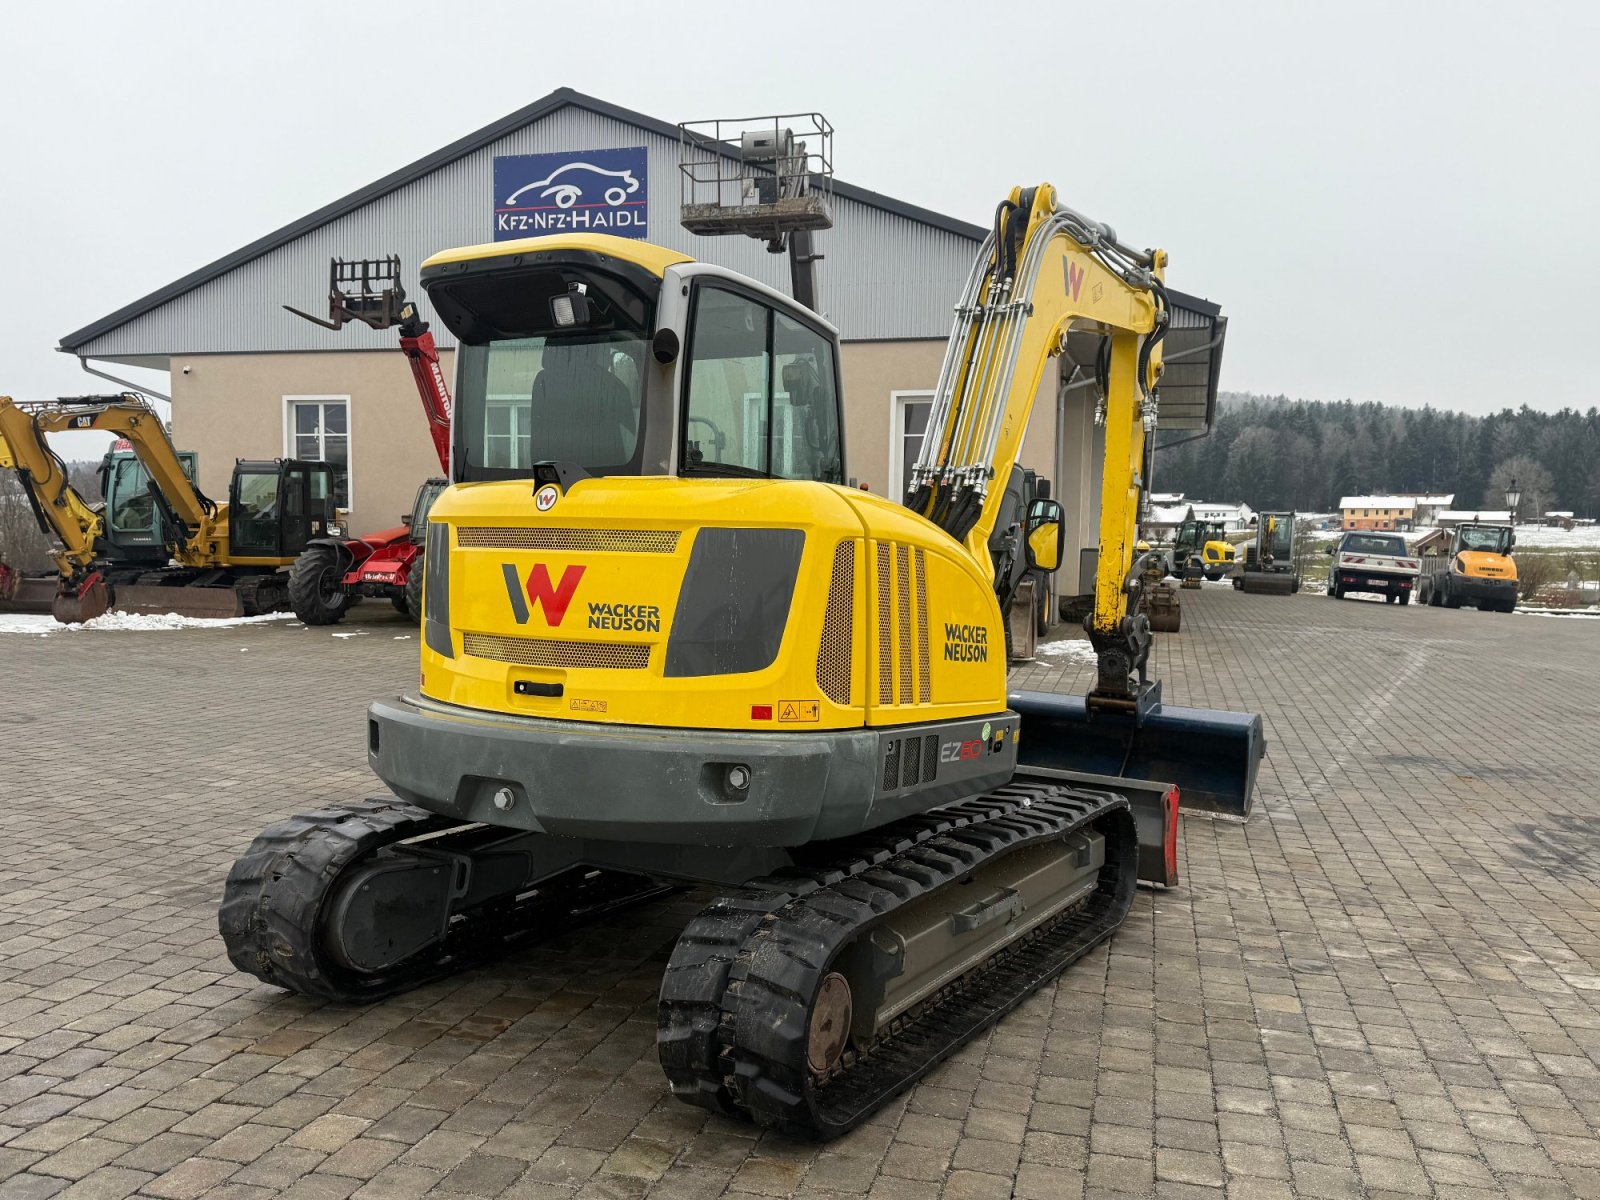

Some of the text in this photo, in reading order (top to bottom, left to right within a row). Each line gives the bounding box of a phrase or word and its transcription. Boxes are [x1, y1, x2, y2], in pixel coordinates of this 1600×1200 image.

[77, 416, 92, 428] CAT
[587, 602, 660, 619] WACKER
[588, 616, 661, 633] NEUSON
[944, 622, 988, 644] WACKER
[944, 642, 988, 663] NEUSON
[940, 739, 984, 763] EZ80
